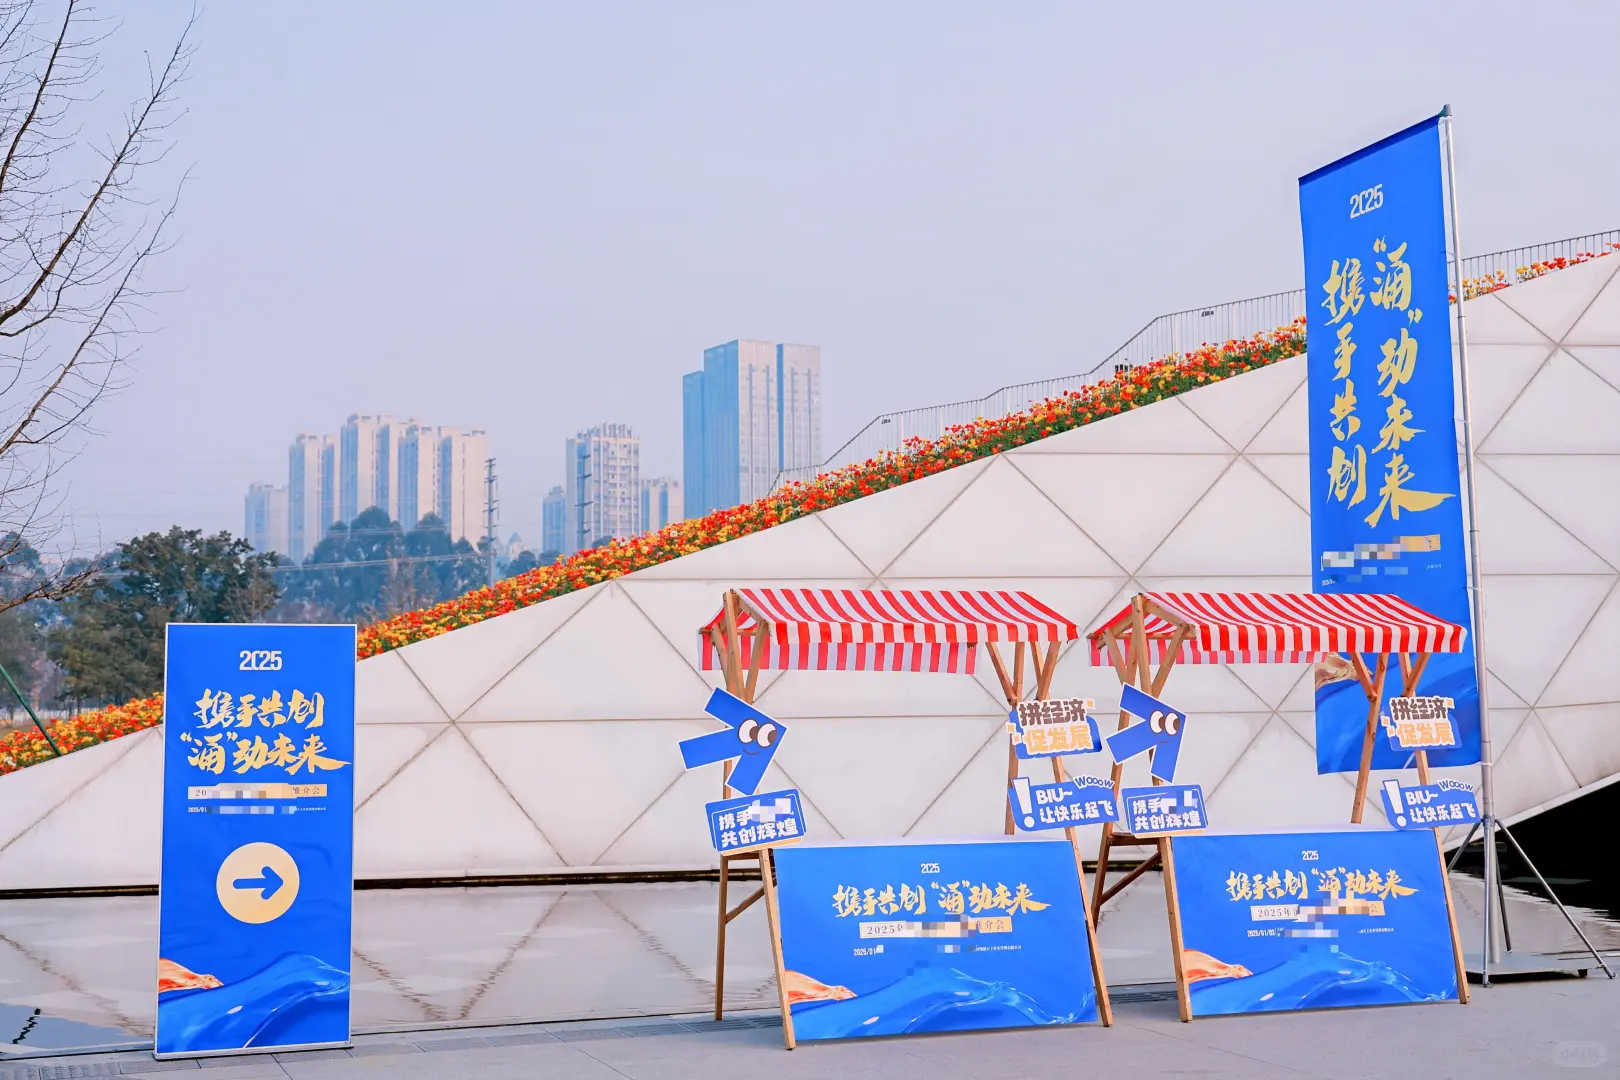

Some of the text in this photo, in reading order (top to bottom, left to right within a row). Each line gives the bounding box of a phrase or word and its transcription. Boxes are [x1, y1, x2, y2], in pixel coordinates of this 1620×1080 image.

[1350, 184, 1384, 219] 2025
[1321, 257, 1367, 510] 携手共创
[239, 650, 282, 671] 2025
[193, 688, 325, 730] 携手共创
[1018, 699, 1086, 727] 拼经济
[1391, 698, 1447, 720] 拼经济
[1025, 724, 1094, 753] 促发展
[1397, 721, 1454, 745] 促发展
[1039, 800, 1115, 824] 让快乐起飞
[1135, 810, 1202, 831] 共创辉煌
[1410, 802, 1477, 823] 让快乐起飞
[721, 817, 799, 848] 共创辉煌
[1301, 851, 1320, 860] 2025
[920, 863, 940, 874] 2025
